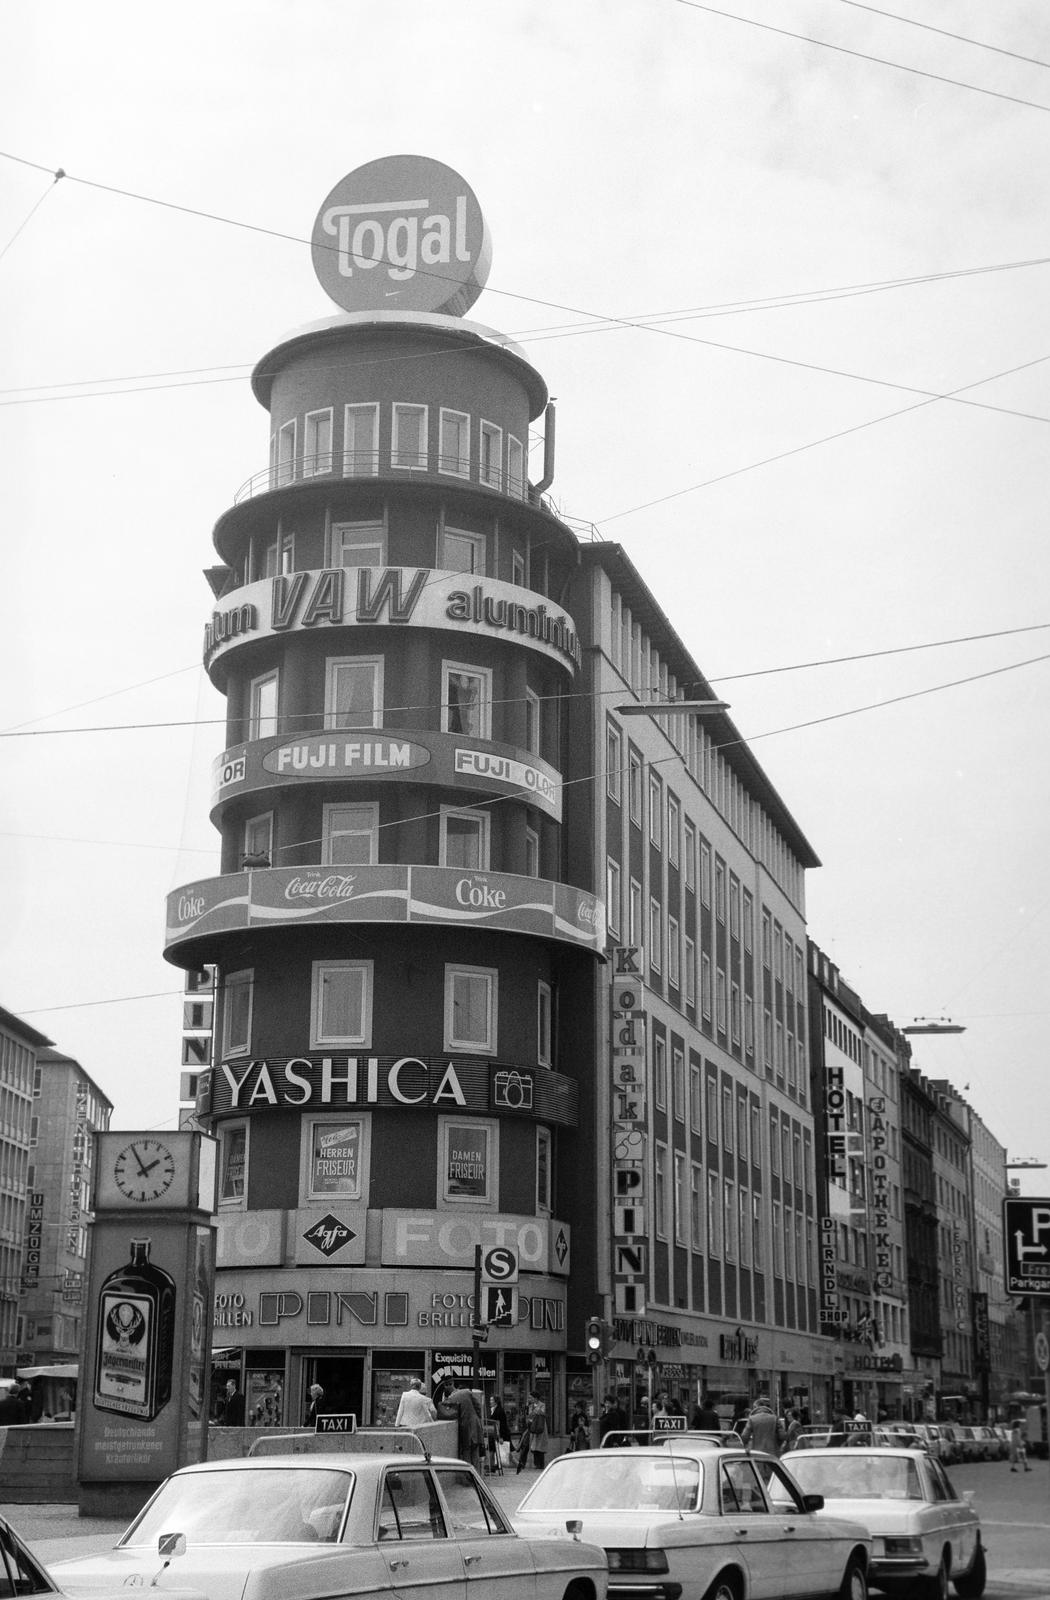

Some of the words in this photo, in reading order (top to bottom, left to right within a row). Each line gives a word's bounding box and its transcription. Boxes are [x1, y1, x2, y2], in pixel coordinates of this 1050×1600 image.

[322, 196, 471, 281] Togal
[270, 567, 431, 631] VAW
[277, 742, 336, 772] FUJI
[344, 742, 411, 768] FILM
[457, 752, 511, 779] FUJI
[284, 875, 358, 900] Coca-Cola
[455, 879, 507, 908] Coke
[178, 896, 205, 921] Coke
[615, 948, 640, 1121] Kodak
[220, 1057, 467, 1107] YASHICA
[828, 1066, 846, 1177] HOTEL
[320, 1147, 354, 1158] HERREN
[452, 1150, 482, 1162] DAMEN
[316, 1159, 355, 1176] FRISEUR
[449, 1162, 484, 1180] FRISEUR
[871, 1117, 890, 1267] APOTHEKE
[307, 1225, 348, 1250] Agfa
[1032, 1207, 1050, 1243] P
[216, 1222, 271, 1257] TO
[396, 1216, 543, 1262] FOTO
[616, 1170, 642, 1312] PINI
[489, 1250, 511, 1277] S
[823, 1218, 836, 1306] DIRNDL
[1010, 1276, 1050, 1291] Parkgar
[213, 1293, 244, 1308] FOTO
[259, 1291, 409, 1326] PINI
[213, 1311, 254, 1327] RILLEN
[418, 1312, 475, 1327] BRILLE
[819, 1311, 849, 1323] SHOP
[434, 1351, 473, 1364] Exquisite
[321, 1418, 348, 1431] TAXI
[658, 1419, 681, 1429] TAXI
[848, 1423, 868, 1431] TAXI
